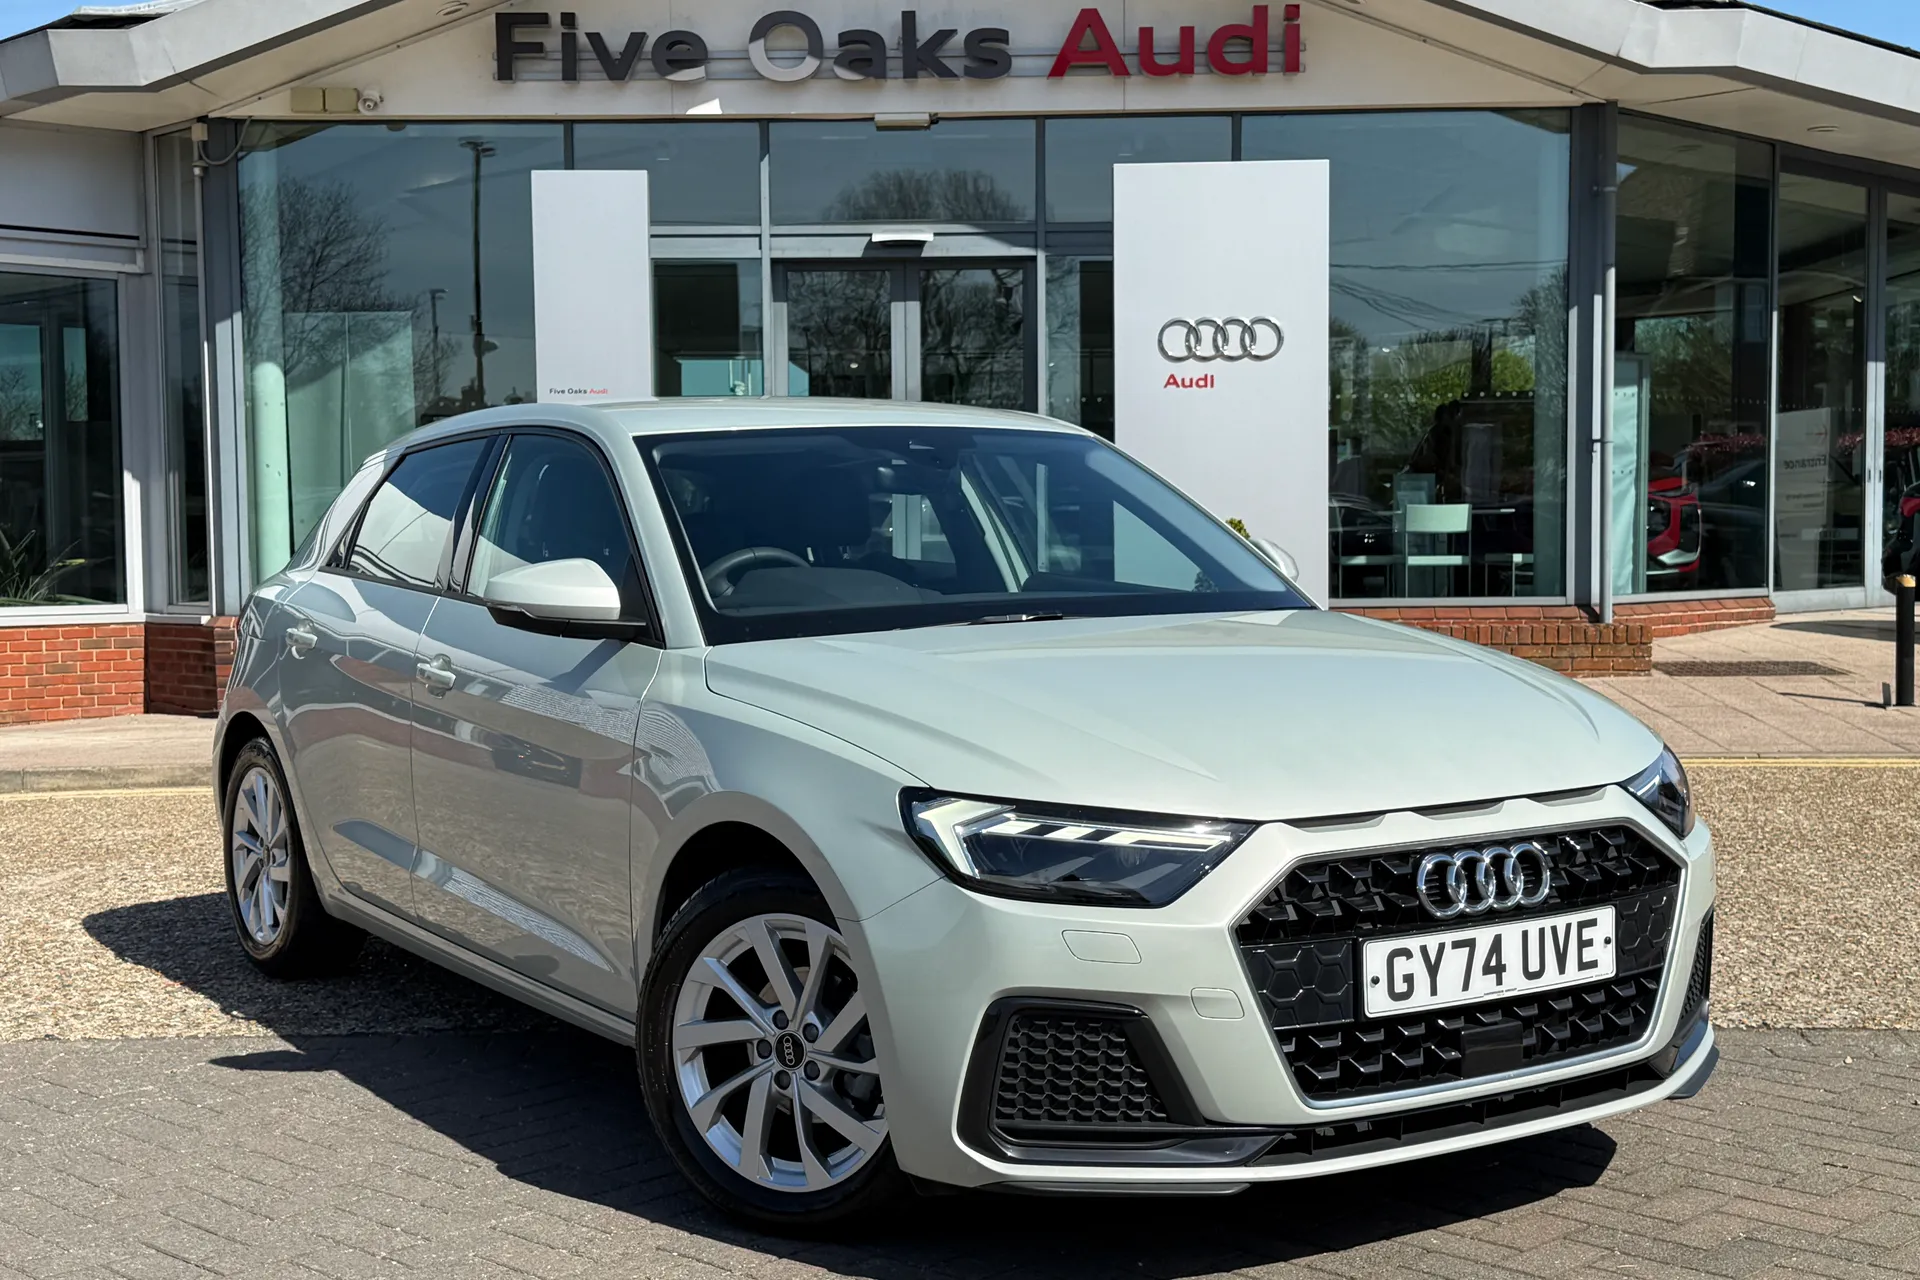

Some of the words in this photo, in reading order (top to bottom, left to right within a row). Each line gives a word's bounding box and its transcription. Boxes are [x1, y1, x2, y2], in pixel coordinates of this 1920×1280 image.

[495, 12, 708, 82] Five
[748, 10, 1012, 82] Oaks
[1047, 3, 1300, 78] Audi
[549, 387, 566, 395] Five
[567, 387, 588, 395] Oaks
[1163, 373, 1215, 389] Audi
[1386, 933, 1507, 1002] GY74
[1521, 917, 1598, 981] UVE
